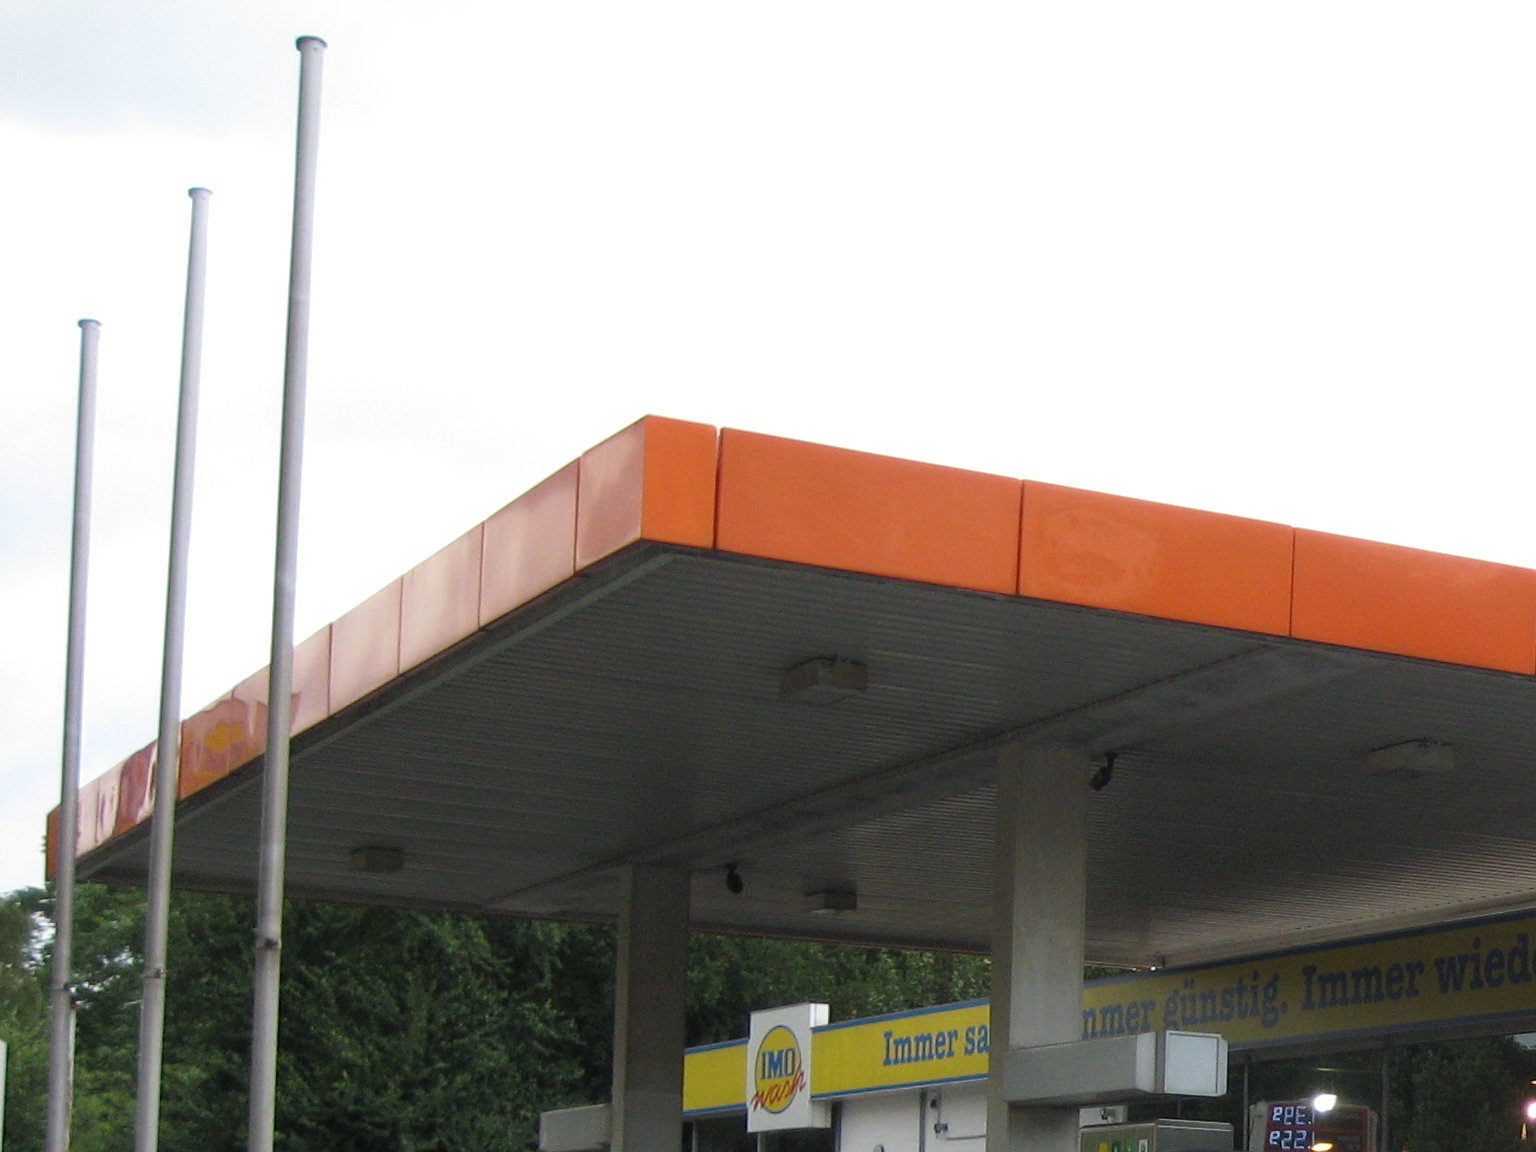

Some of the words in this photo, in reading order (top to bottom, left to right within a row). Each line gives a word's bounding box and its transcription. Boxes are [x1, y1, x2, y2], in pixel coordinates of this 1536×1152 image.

[882, 1029, 958, 1066] Immer
[964, 1023, 990, 1056] sa
[1082, 998, 1155, 1040] mmer
[1164, 969, 1288, 1029] günstig.
[1302, 960, 1425, 1011] Immer
[750, 1061, 807, 1112] wash
[761, 1047, 796, 1080] IMO
